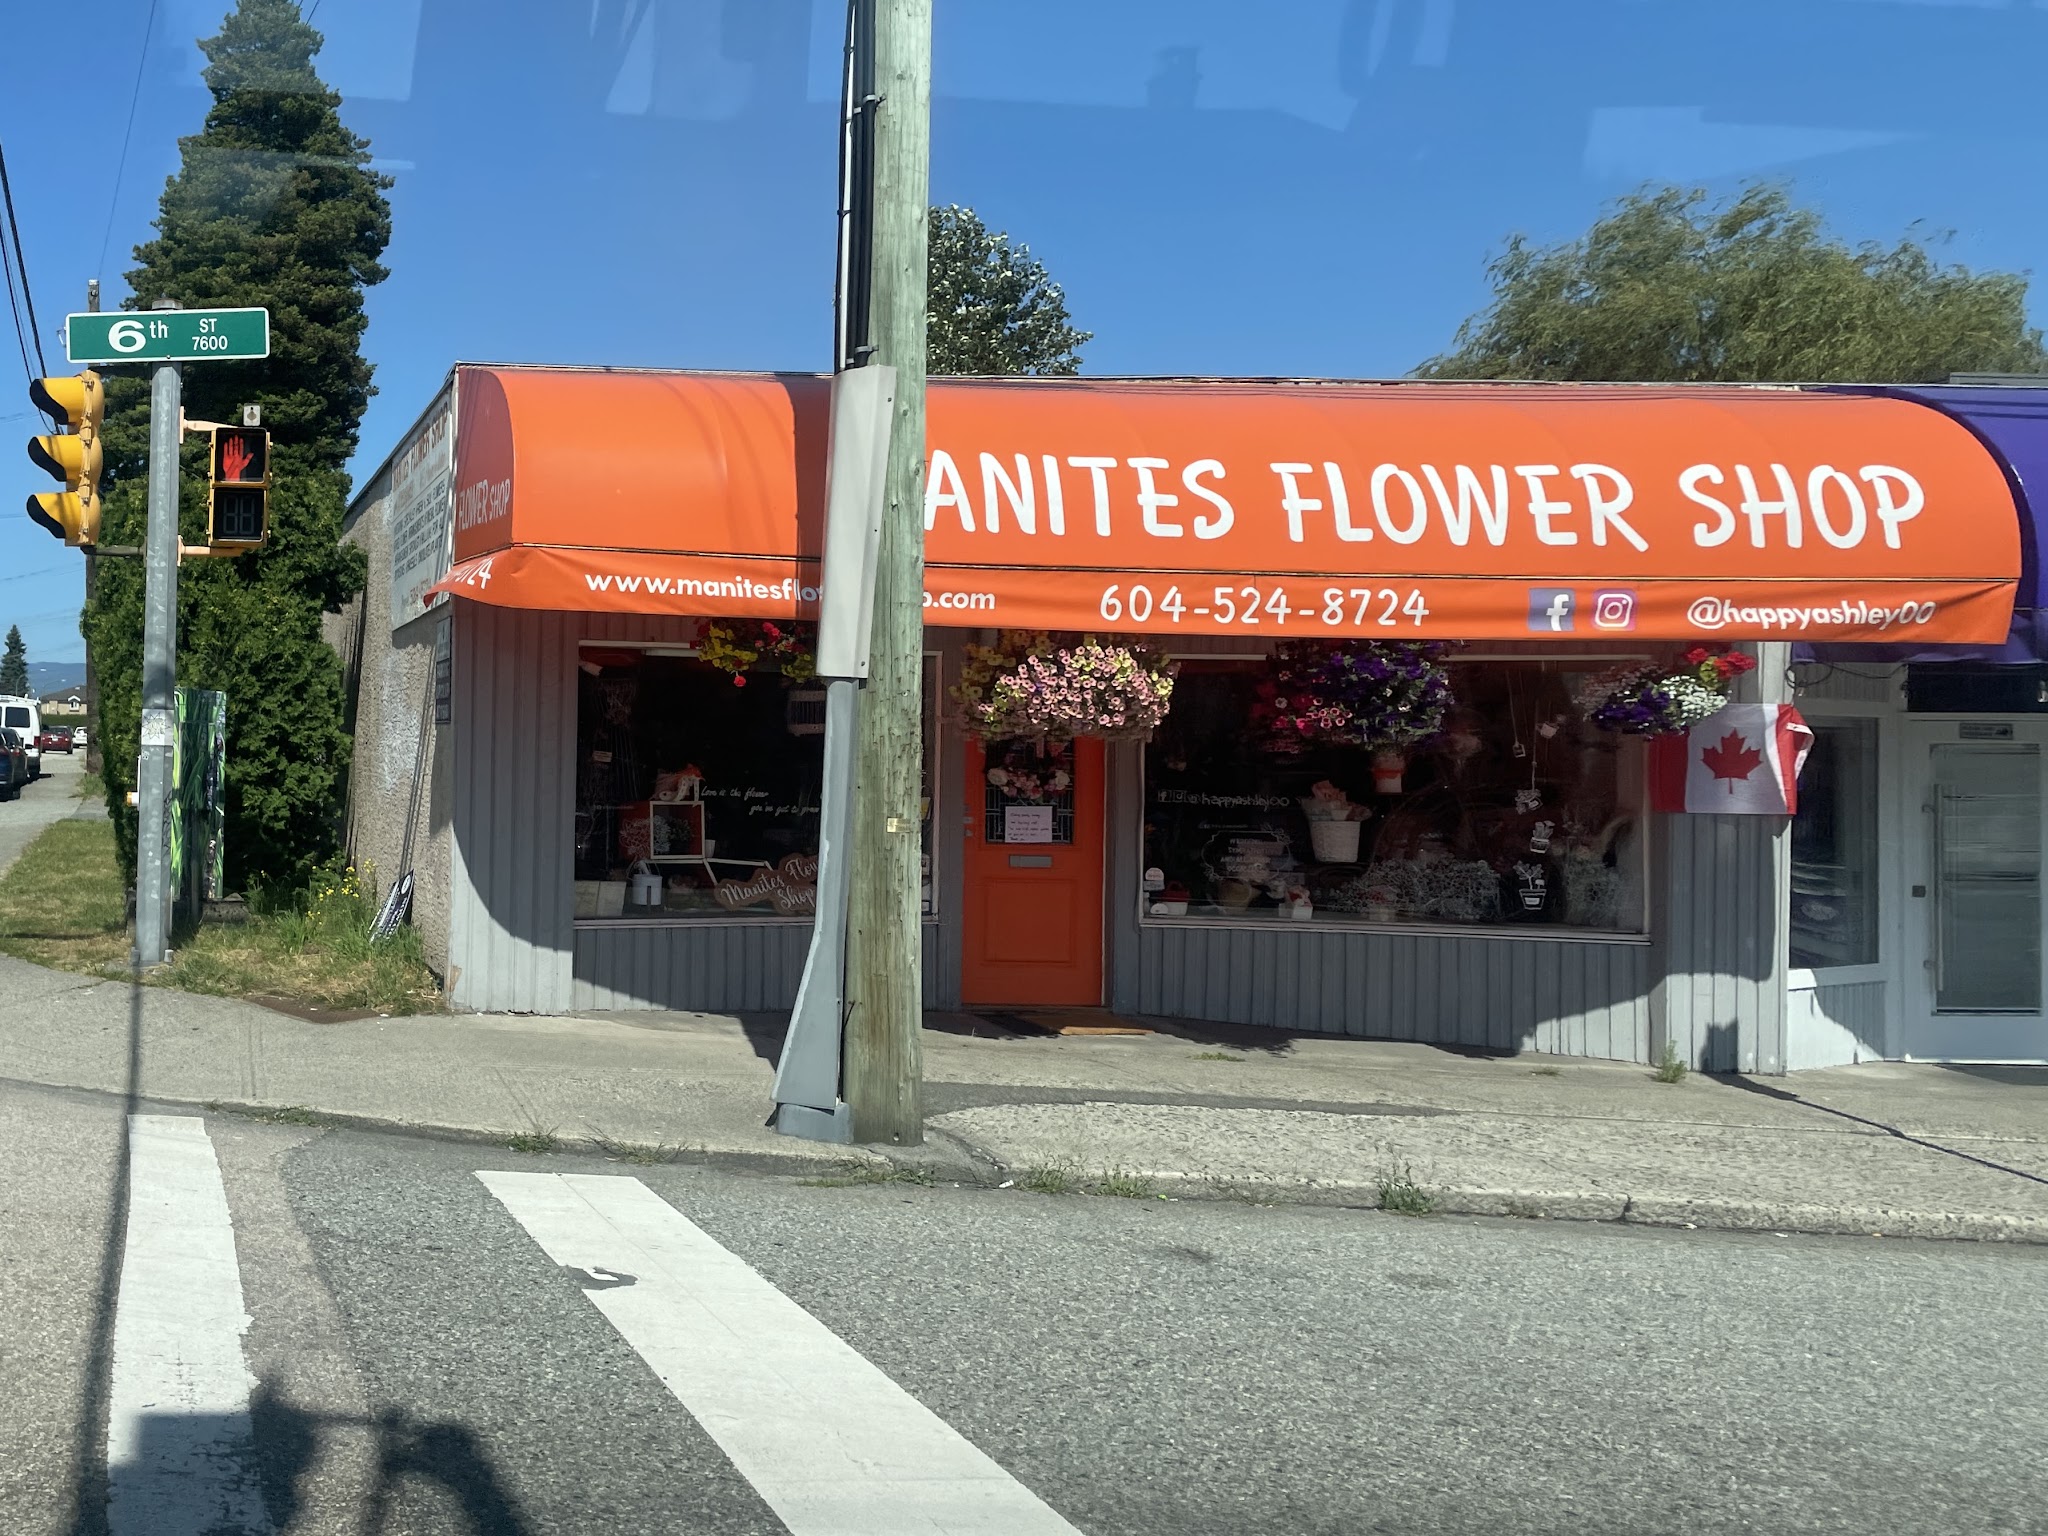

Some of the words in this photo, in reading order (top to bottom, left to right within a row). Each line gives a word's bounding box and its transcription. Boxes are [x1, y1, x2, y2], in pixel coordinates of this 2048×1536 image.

[108, 320, 169, 353] 6th
[199, 318, 217, 333] ST
[192, 335, 228, 351] 7600
[458, 479, 489, 533] FLOWER
[489, 478, 511, 523] SHOP
[924, 449, 1235, 540] ANITES
[1270, 461, 1649, 553] FLOWER
[1678, 463, 1925, 549] SHOP
[1100, 584, 1430, 627] 604-524-8724
[1687, 596, 1936, 631] @happyashley00
[720, 873, 785, 905] Manites
[777, 885, 816, 909] Shop
